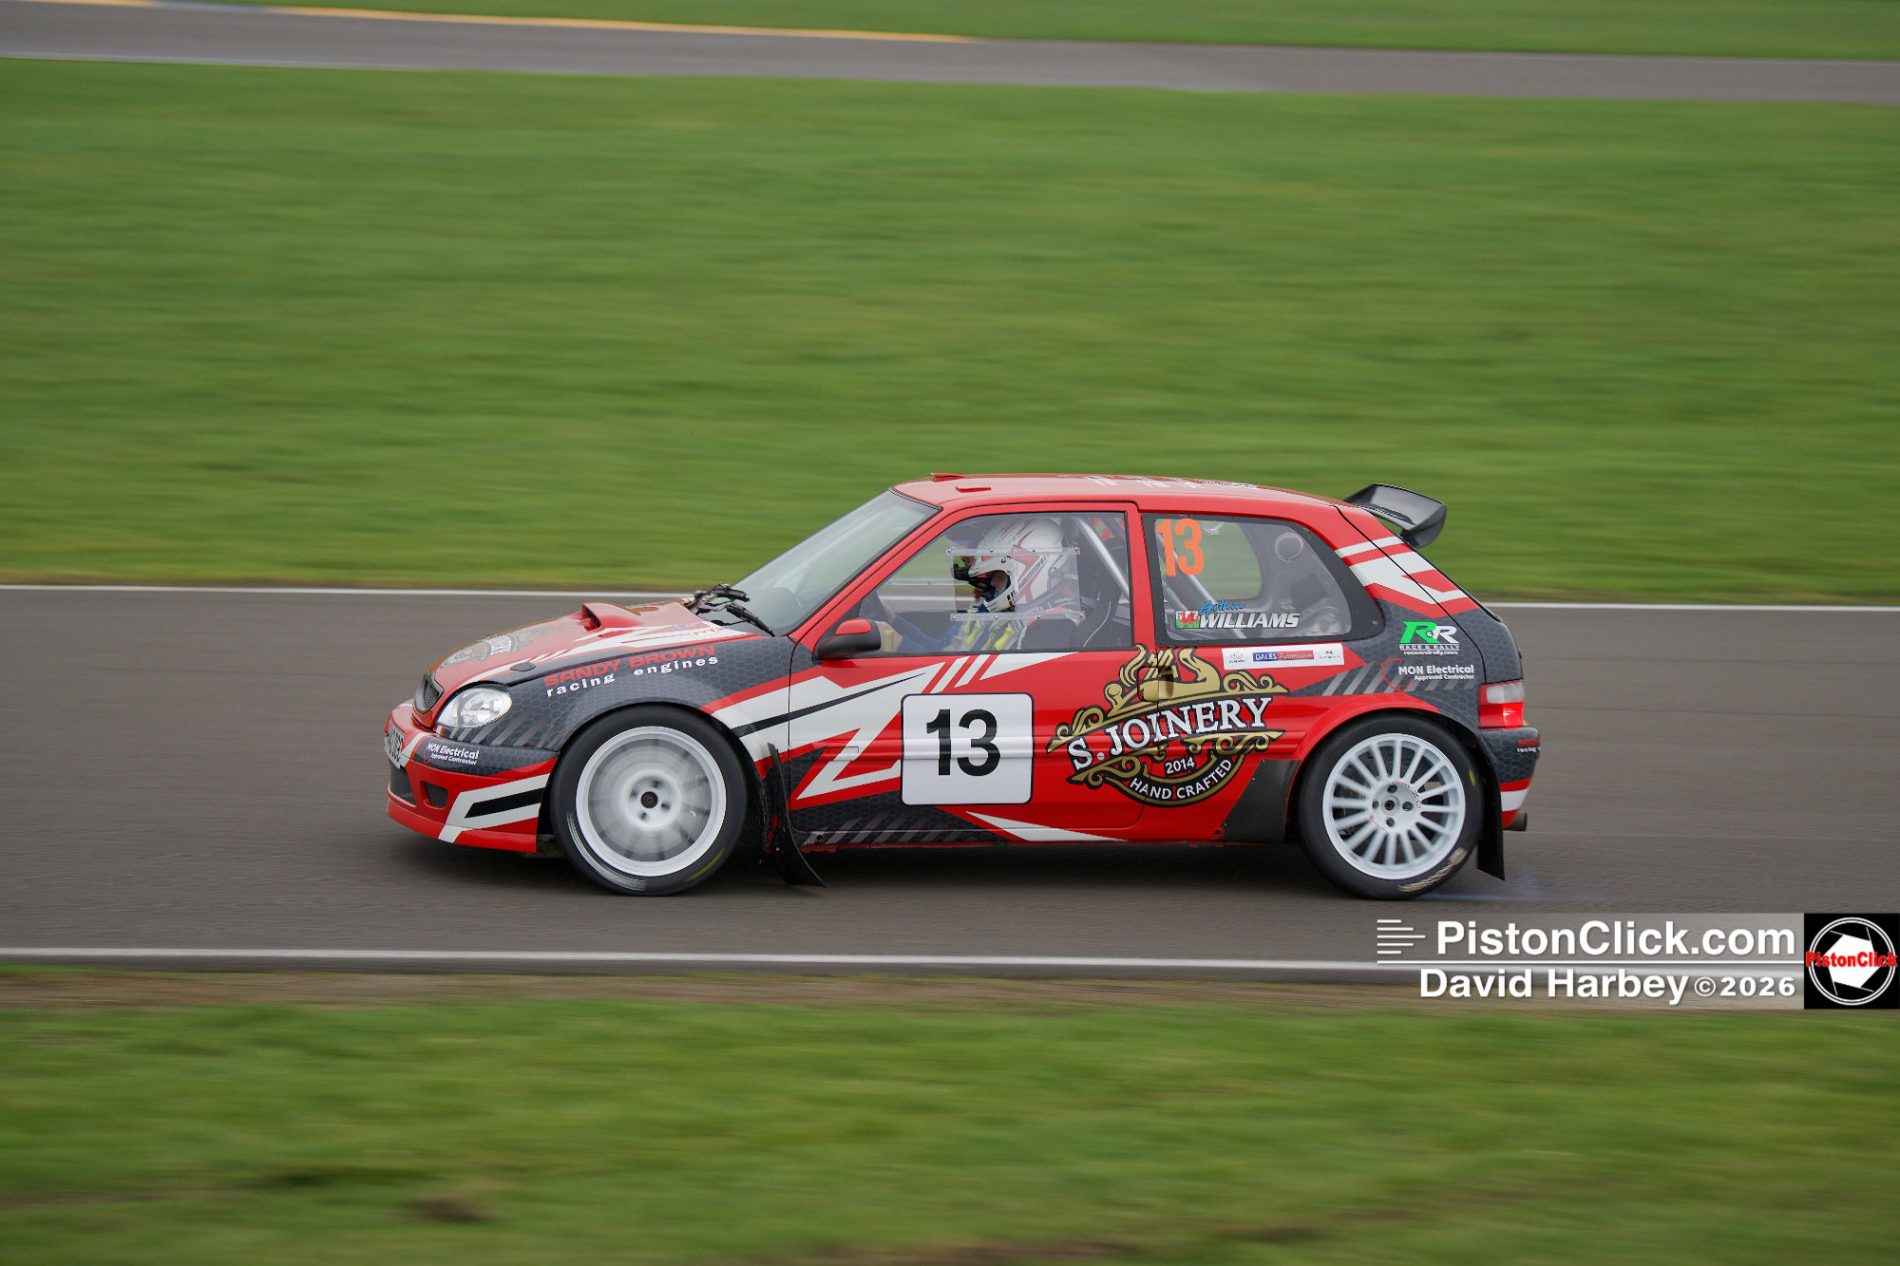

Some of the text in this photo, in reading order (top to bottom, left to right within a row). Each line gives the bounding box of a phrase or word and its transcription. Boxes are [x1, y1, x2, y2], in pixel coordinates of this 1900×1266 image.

[1155, 518, 1204, 577] 13
[1200, 613, 1300, 629] WILLIAMS
[543, 645, 716, 687] SANDY BROWN
[546, 656, 719, 698] racing engines
[1255, 653, 1278, 661] DALES
[1398, 664, 1475, 675] MON Electrical
[926, 709, 1001, 777] 13
[1106, 697, 1271, 757] JOINERY
[440, 745, 480, 760] Electrical
[1164, 756, 1196, 775] 2014
[1129, 759, 1233, 800] HAND CRAFTED
